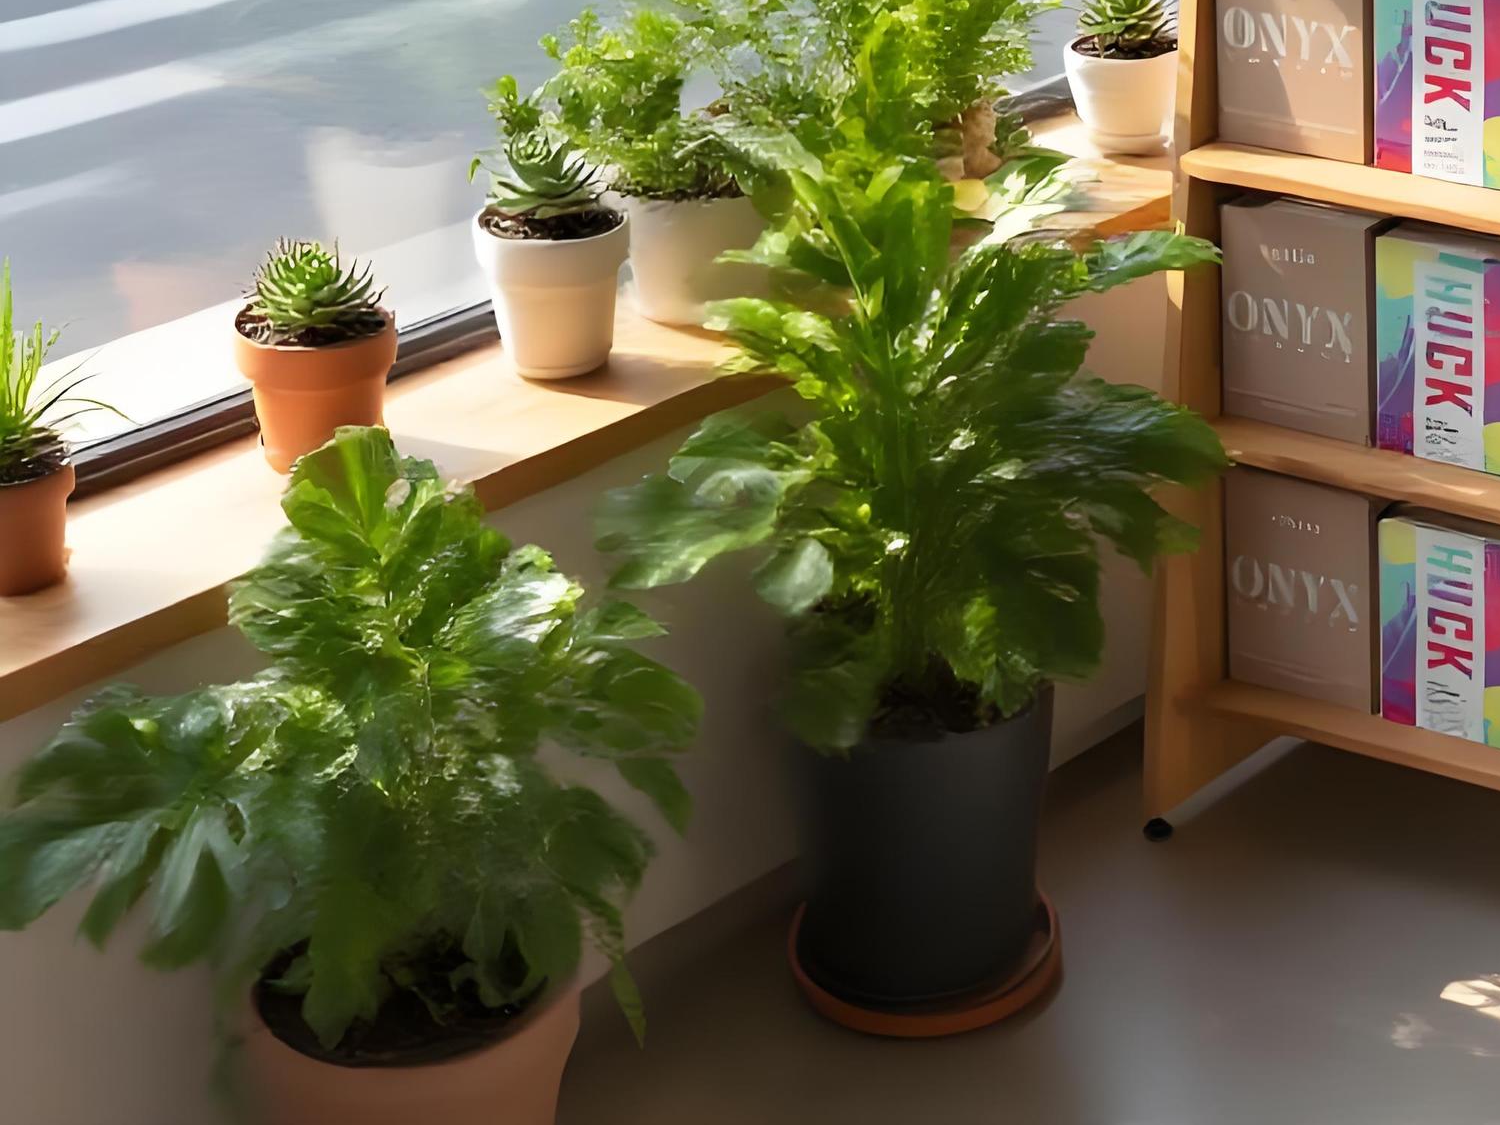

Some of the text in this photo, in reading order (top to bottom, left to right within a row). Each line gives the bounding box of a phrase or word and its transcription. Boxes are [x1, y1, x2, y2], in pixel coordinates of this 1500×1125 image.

[1223, 7, 1358, 69] ONYX
[1228, 290, 1353, 355] ONYX
[1424, 275, 1473, 418] HUCK
[1231, 555, 1359, 624] ONYX
[1426, 545, 1473, 680] HUCK
